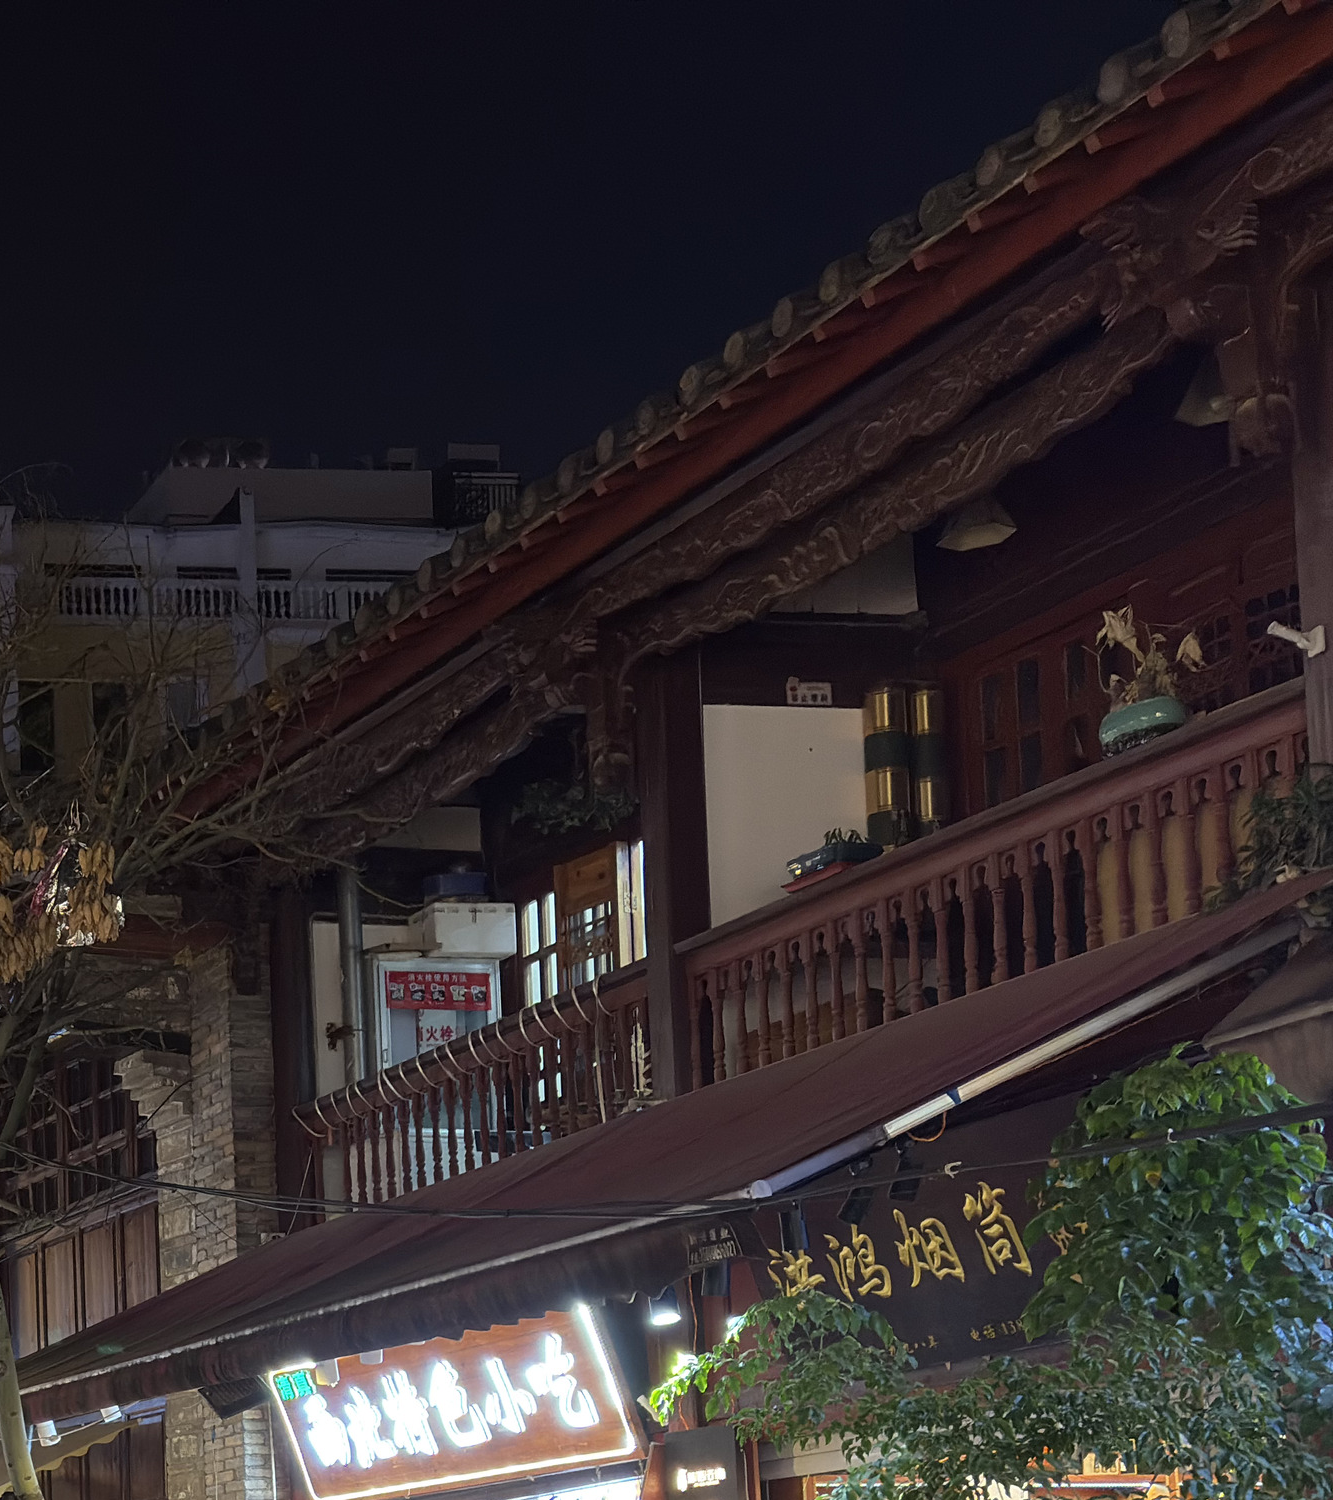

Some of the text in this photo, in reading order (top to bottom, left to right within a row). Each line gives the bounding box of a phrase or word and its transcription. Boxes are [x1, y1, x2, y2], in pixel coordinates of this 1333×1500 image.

[304, 1333, 600, 1468] 西北特色小吃
